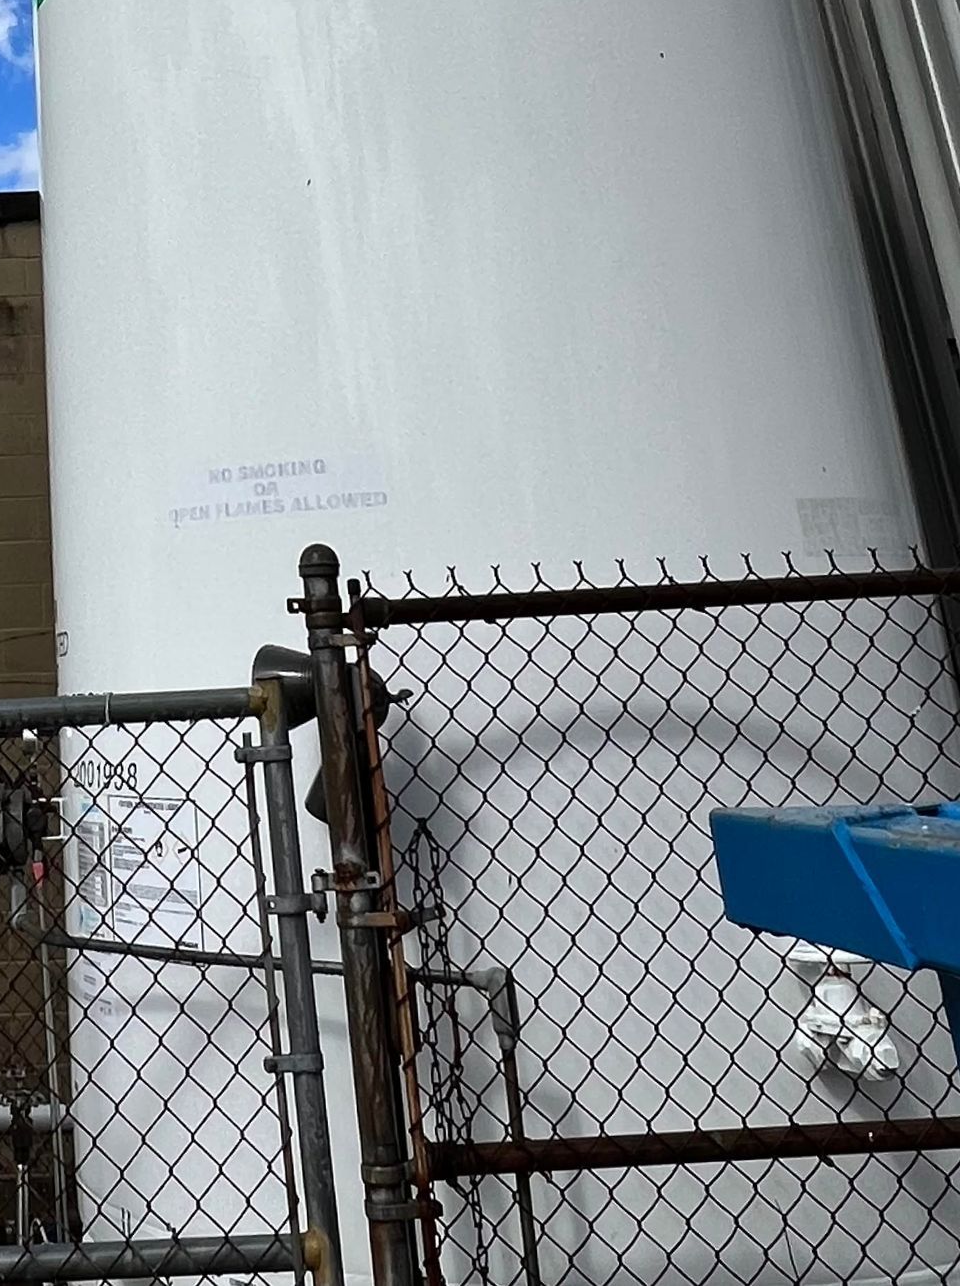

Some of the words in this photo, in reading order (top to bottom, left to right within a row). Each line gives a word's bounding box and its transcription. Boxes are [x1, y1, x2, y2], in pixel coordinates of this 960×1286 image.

[208, 468, 232, 484] NO
[238, 459, 327, 480] SMOKING
[253, 481, 279, 496] OR
[168, 503, 210, 523] OPEN
[216, 497, 285, 518] FLAMES
[290, 491, 387, 512] ALLOWED
